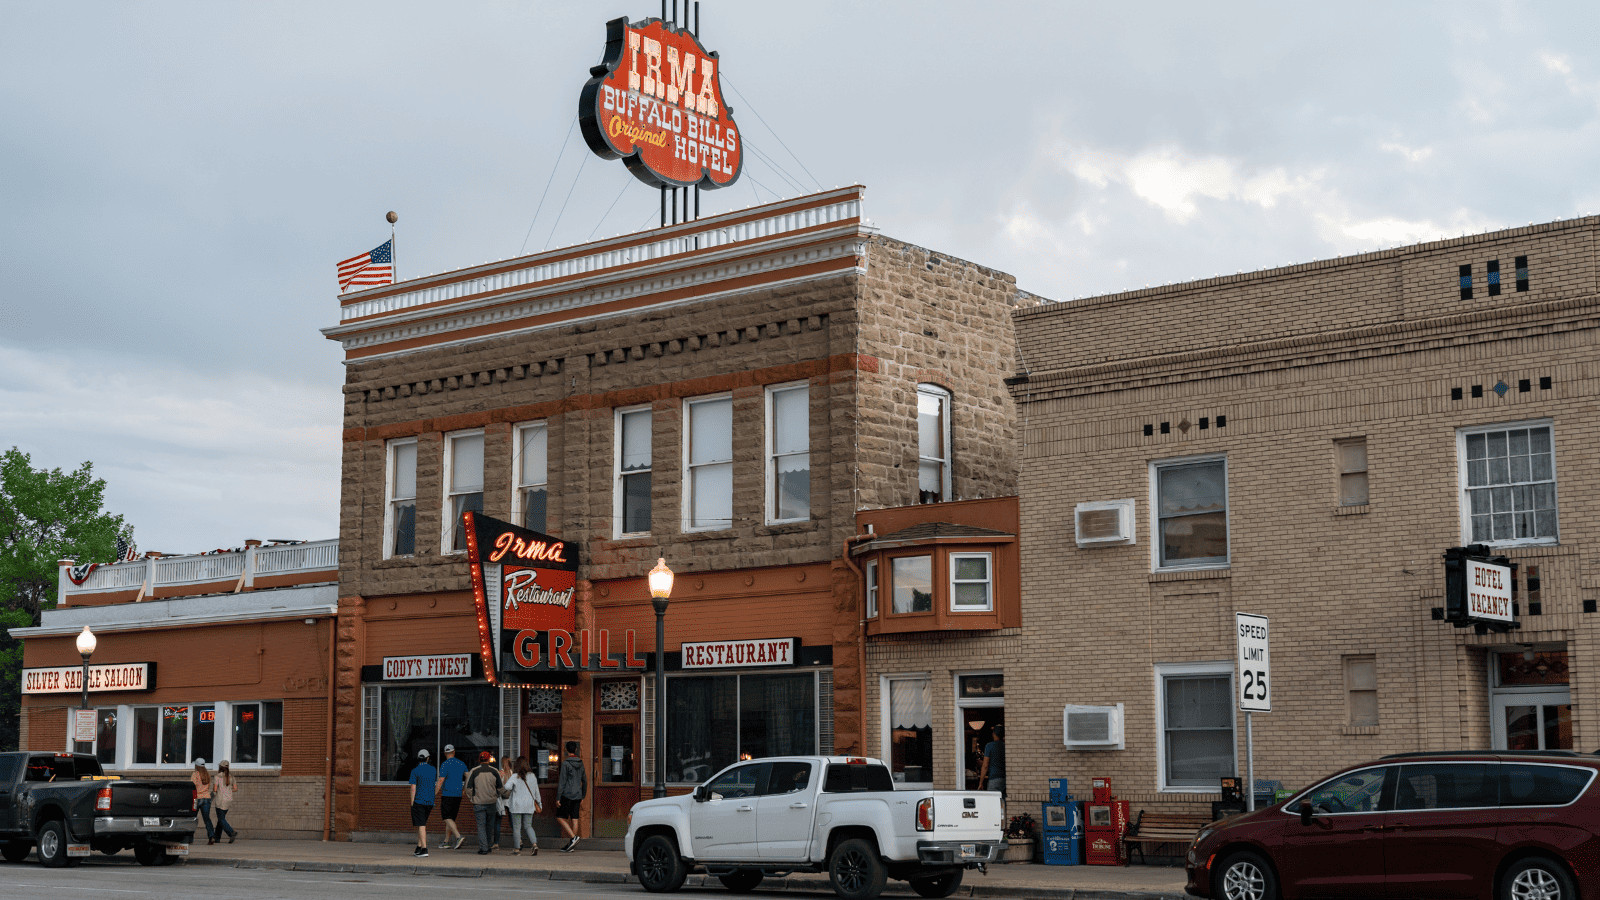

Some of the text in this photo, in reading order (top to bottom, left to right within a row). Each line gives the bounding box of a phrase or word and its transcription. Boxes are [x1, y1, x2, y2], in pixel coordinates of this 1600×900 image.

[628, 30, 719, 119] IRMA
[603, 84, 736, 152] BUFFALO BILLS
[609, 115, 667, 148] Original
[674, 134, 733, 176] HOTEL
[489, 531, 567, 562] Irma
[504, 569, 575, 610] Restaurant
[1475, 566, 1503, 590] HOTEL
[1470, 592, 1509, 616] VACANCY
[1240, 624, 1266, 640] SPEED
[513, 629, 646, 669] GRILL
[685, 641, 790, 666] RESTAURANT
[1243, 646, 1264, 662] LIMIT
[27, 667, 143, 690] SILVER SADLE SALOON
[386, 657, 468, 678] CODY'S FINEST
[1243, 669, 1267, 701] 25
[962, 811, 979, 819] GMC
